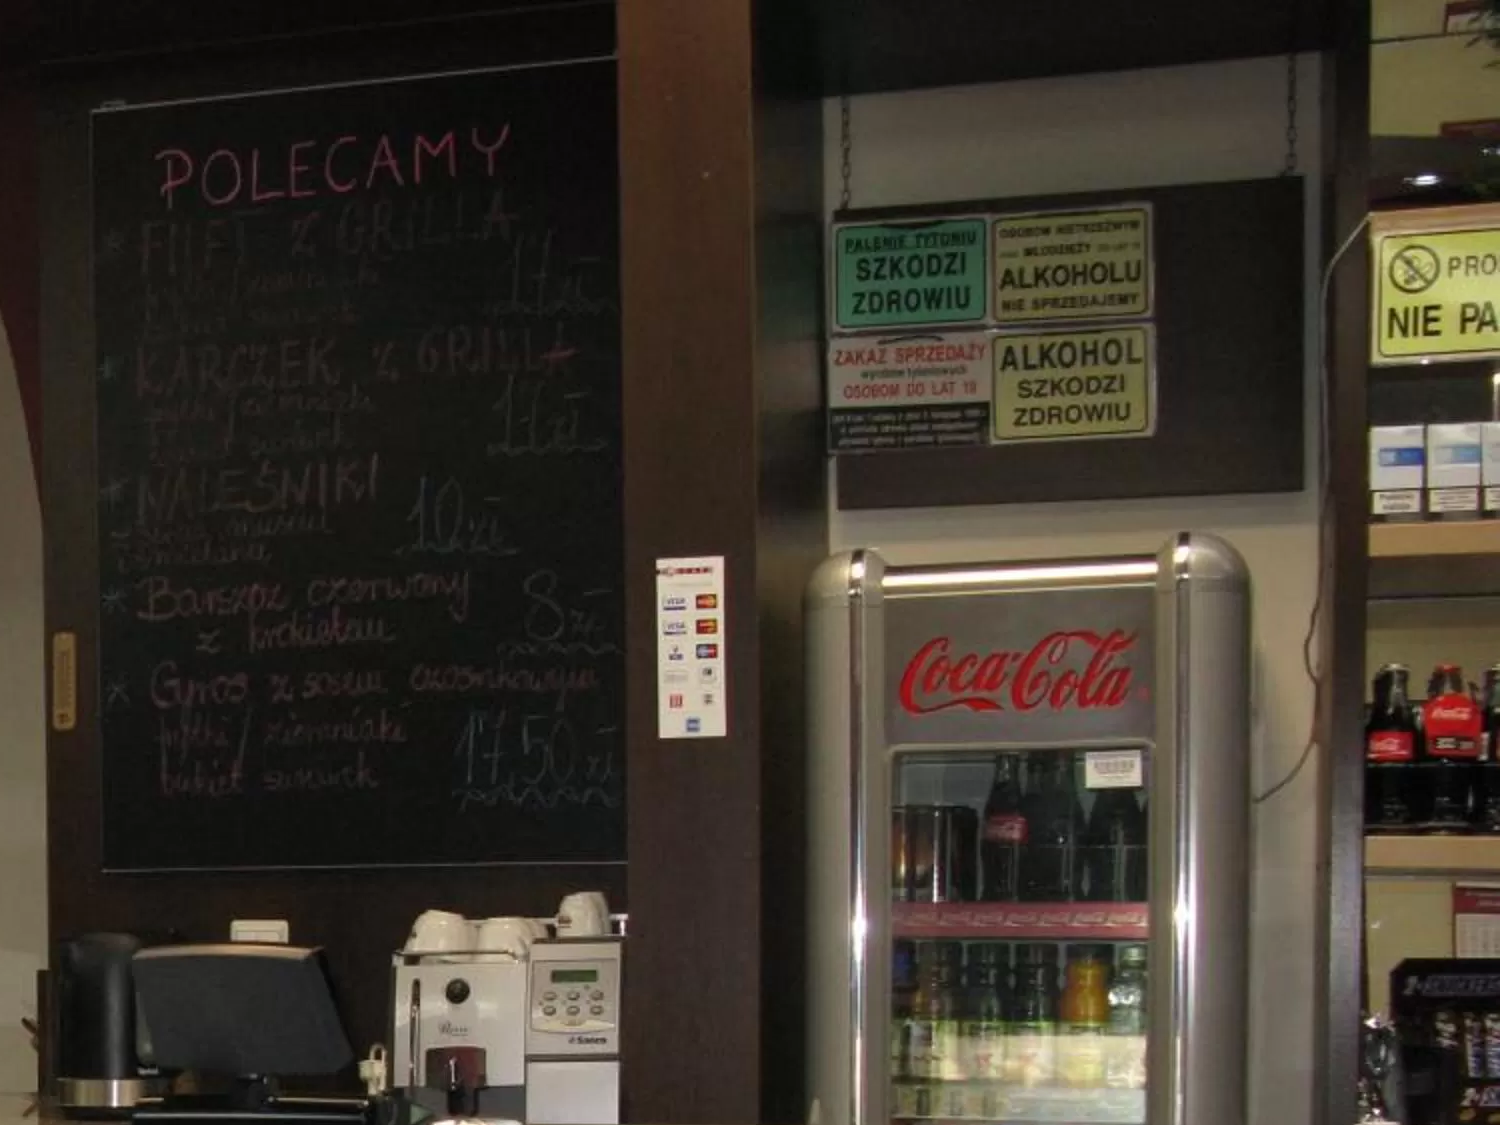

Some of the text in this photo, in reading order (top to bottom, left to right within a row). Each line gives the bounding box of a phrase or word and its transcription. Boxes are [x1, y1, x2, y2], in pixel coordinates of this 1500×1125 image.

[155, 124, 511, 208] POLECAMY
[845, 230, 977, 254] PALENIE TYTONIU
[856, 252, 967, 282] SZKODZI
[999, 260, 1142, 291] ALKOHOLU
[1447, 253, 1500, 279] PRO
[852, 285, 971, 315] ZDROWIU
[1001, 292, 1140, 312] NIE SPRZEDAJEMY
[1387, 304, 1442, 338] NIE
[834, 341, 987, 366] ZAKAZ SPRZEDAŻY
[1000, 337, 1143, 372] ALKOHOL
[843, 384, 900, 400] OSOBOM
[906, 382, 925, 397] DO
[931, 381, 957, 396] LAT
[1017, 373, 1125, 399] SZKODZI
[1012, 402, 1131, 428] ZDROWIU
[898, 628, 1139, 716] Coca-Cola
